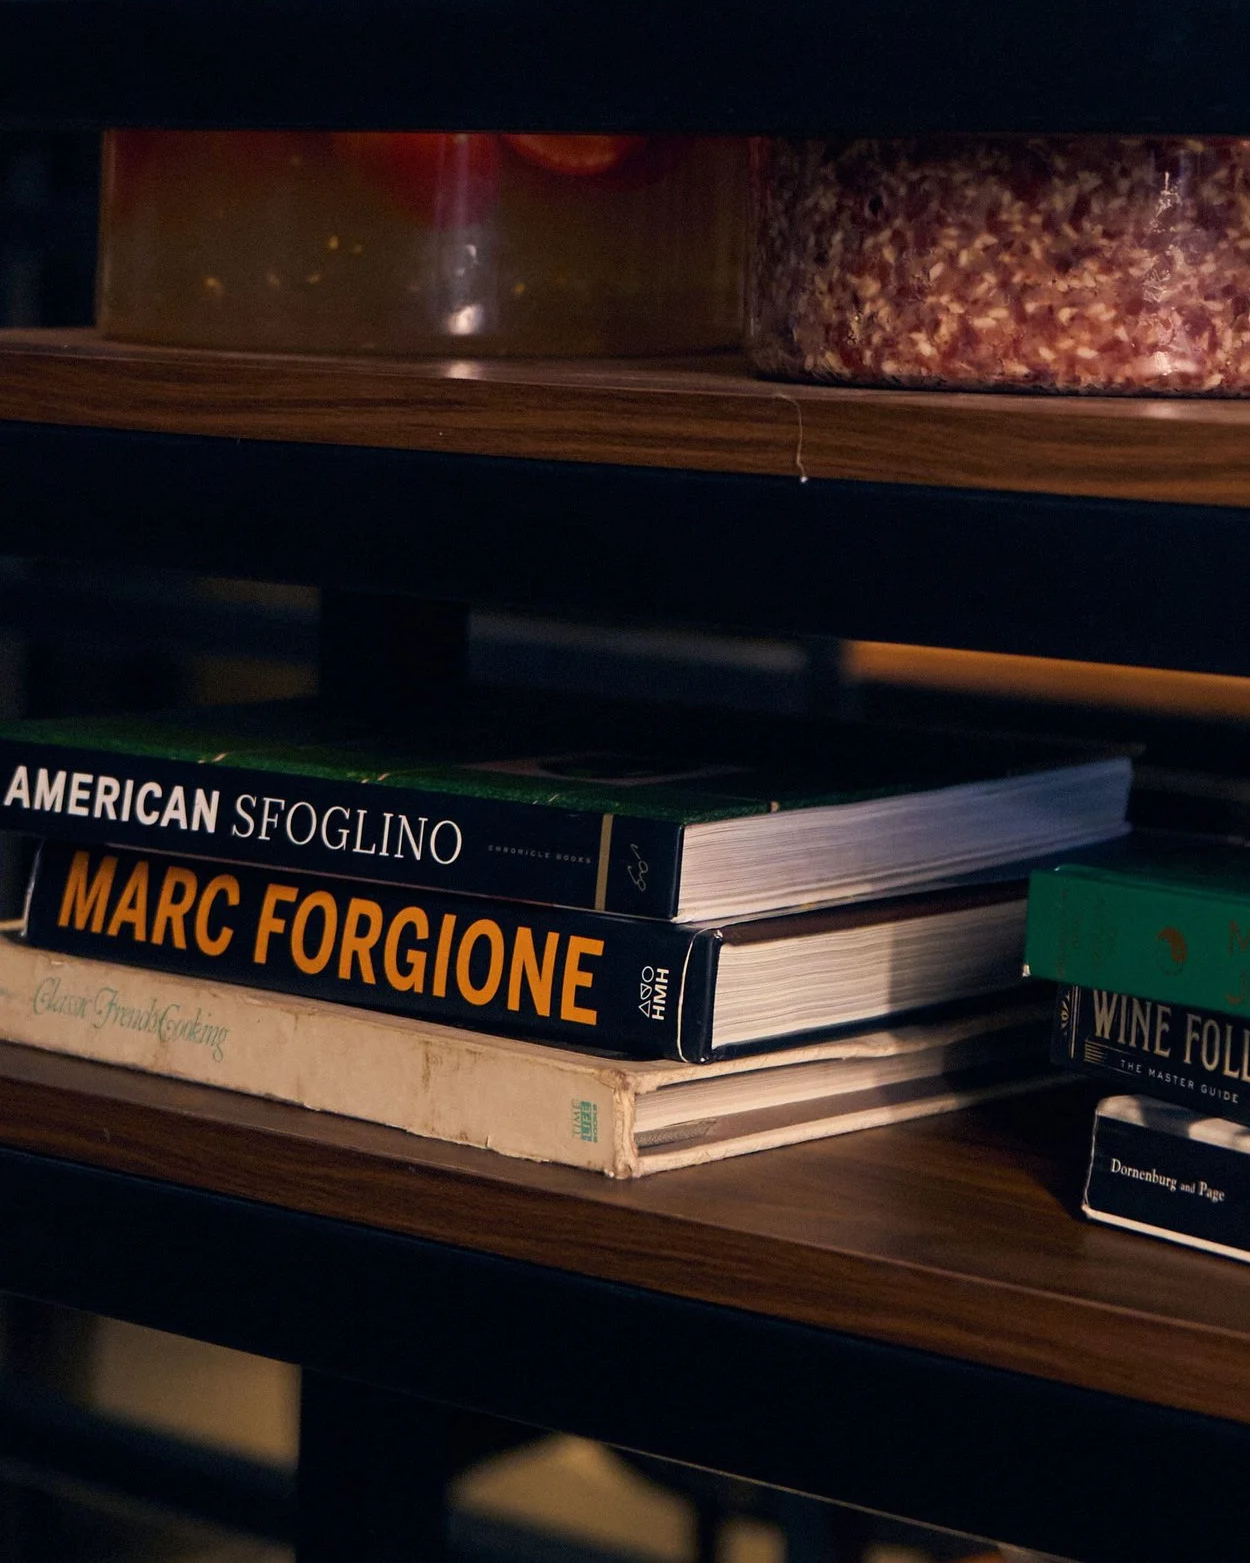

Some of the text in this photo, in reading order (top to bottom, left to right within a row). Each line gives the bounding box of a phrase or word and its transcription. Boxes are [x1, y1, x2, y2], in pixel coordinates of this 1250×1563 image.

[4, 765, 463, 866] AMERICAN SFOGLINO
[488, 844, 592, 864] CHRONICLE BOOKS
[57, 851, 605, 1026] MARC FORGIONE
[651, 967, 670, 1021] HMH
[157, 1003, 231, 1063] Cooking
[1092, 989, 1172, 1058] WINE
[1119, 1058, 1240, 1104] THE MASTER GUIDE
[1110, 1157, 1225, 1204] Dornenburg and Page
